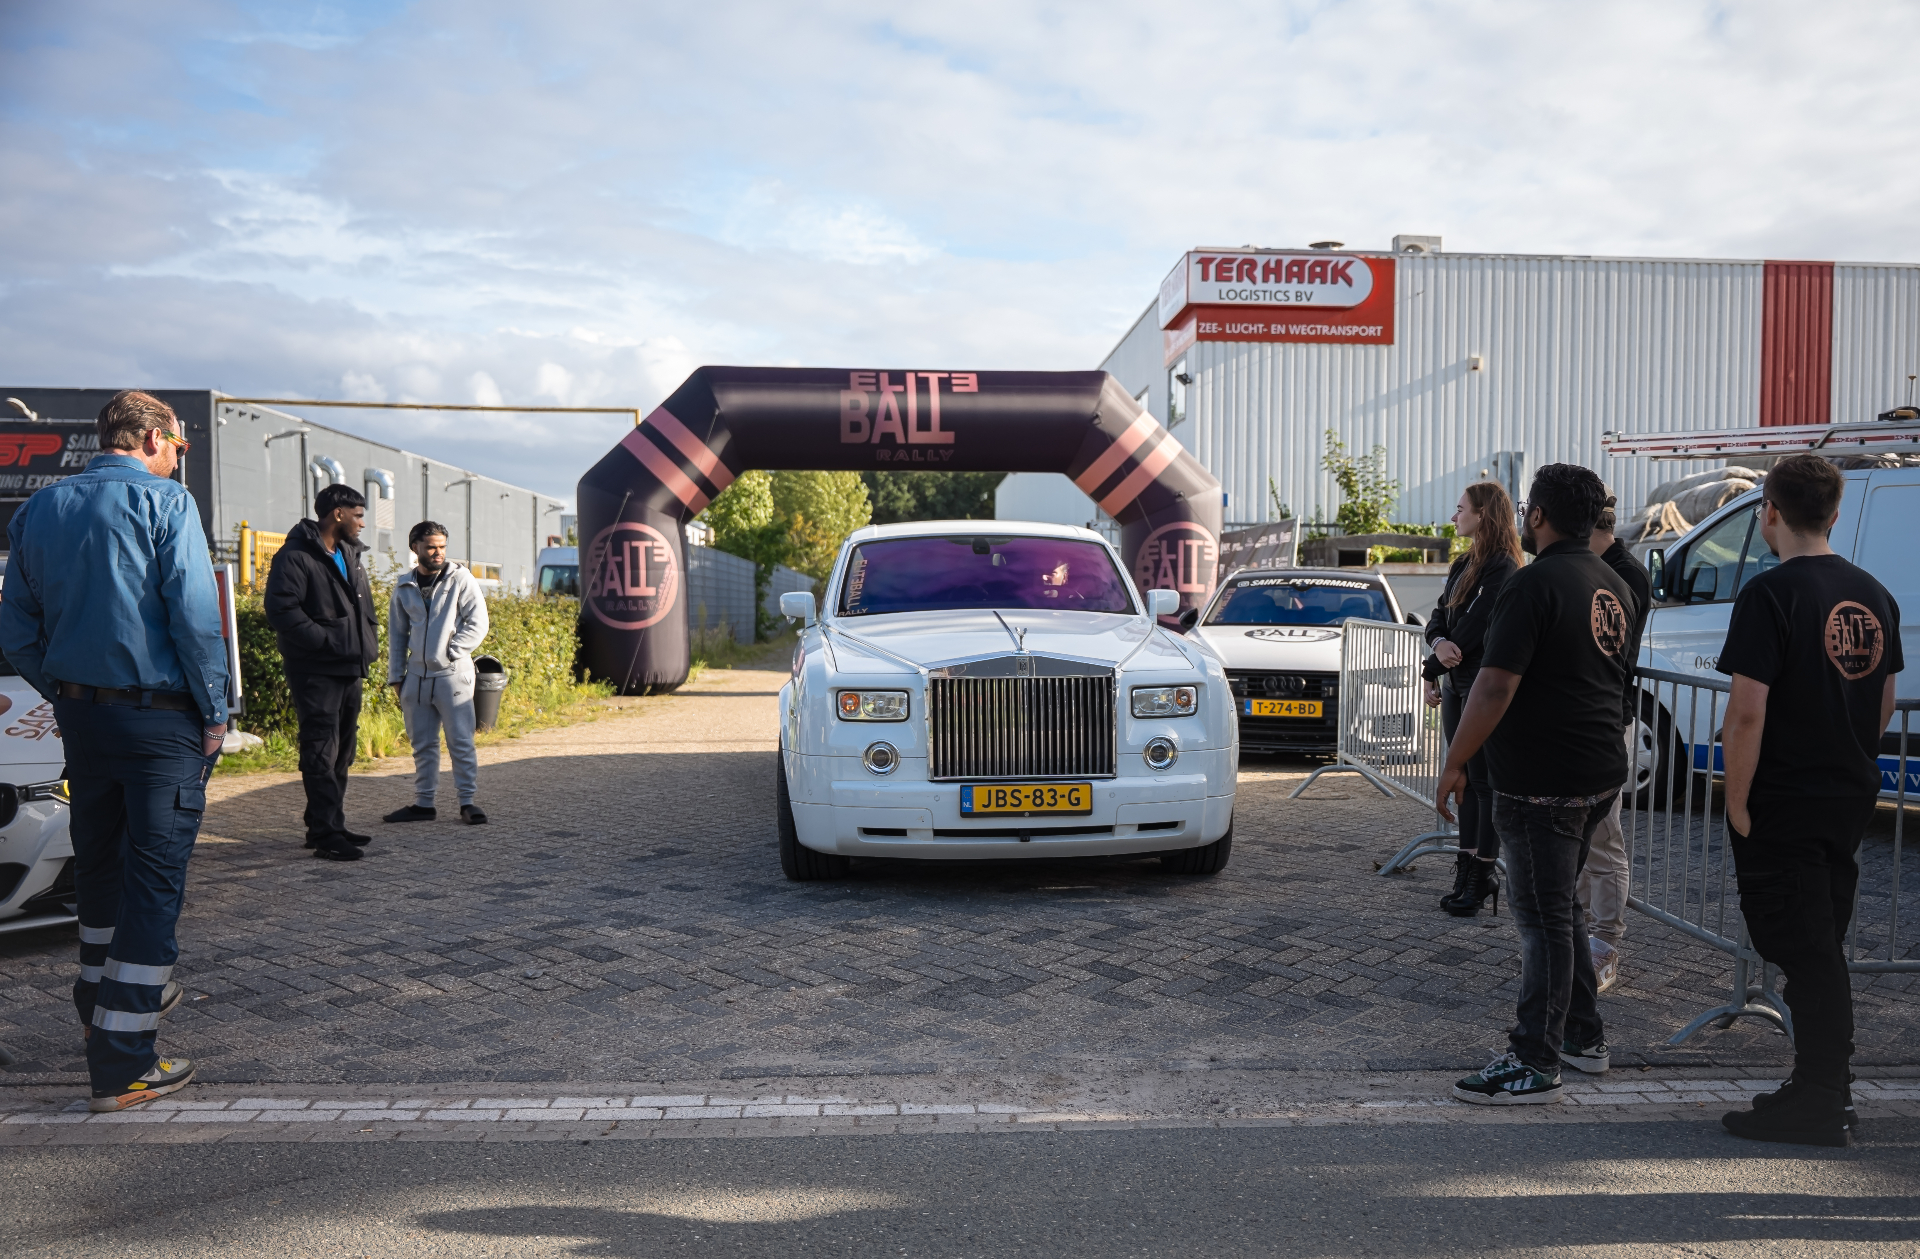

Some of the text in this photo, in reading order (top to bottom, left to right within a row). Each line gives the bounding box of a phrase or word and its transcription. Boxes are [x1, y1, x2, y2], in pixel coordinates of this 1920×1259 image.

[1195, 257, 1258, 286] TER
[1262, 258, 1357, 289] HAAK
[1218, 288, 1314, 302] LOGISTICS BV
[1198, 322, 1384, 337] ZEE- LUCHT- EN WEGTRANSPORT
[840, 388, 956, 444] BALL
[875, 448, 955, 462] RALLY
[605, 600, 657, 612] RALLY
[838, 607, 869, 617] RALLY
[1256, 701, 1317, 715] T-274-BD
[981, 787, 1082, 809] JBS-83-G
